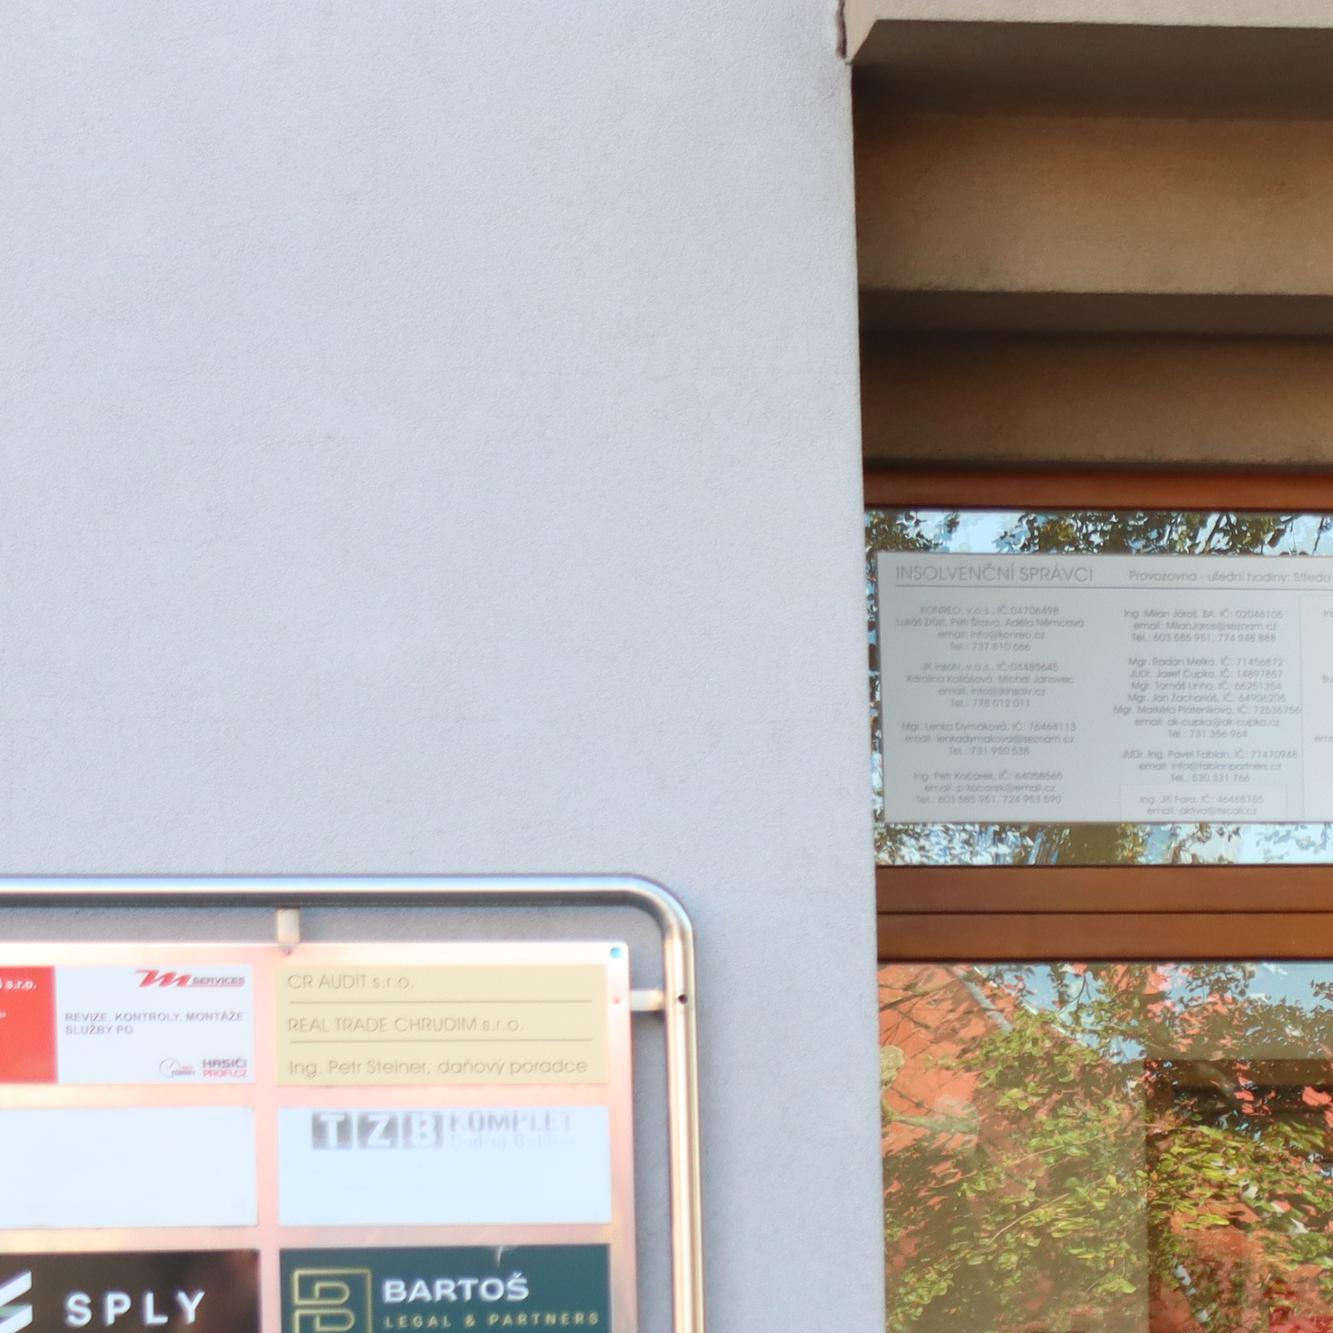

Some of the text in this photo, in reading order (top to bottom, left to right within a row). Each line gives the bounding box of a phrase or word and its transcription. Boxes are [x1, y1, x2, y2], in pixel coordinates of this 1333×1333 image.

[896, 563, 1094, 583] INSOLVENČNÍ SPRÁVCI
[288, 974, 414, 990] CR AUDIT s.r.o.
[65, 1024, 112, 1035] SLUŽBY
[288, 1017, 525, 1033] REAL TRADE CHRUDIM s.r.o.
[289, 1060, 321, 1078] Ing.
[329, 1059, 361, 1074] Petr
[438, 1058, 505, 1075] daňový
[510, 1058, 588, 1075] poradce
[313, 1112, 443, 1149] TZB
[383, 1272, 529, 1304] BARTOŠ
[63, 1290, 205, 1328] SPLY
[384, 1314, 452, 1329] LEGAL
[488, 1312, 600, 1327] PARTNERS
